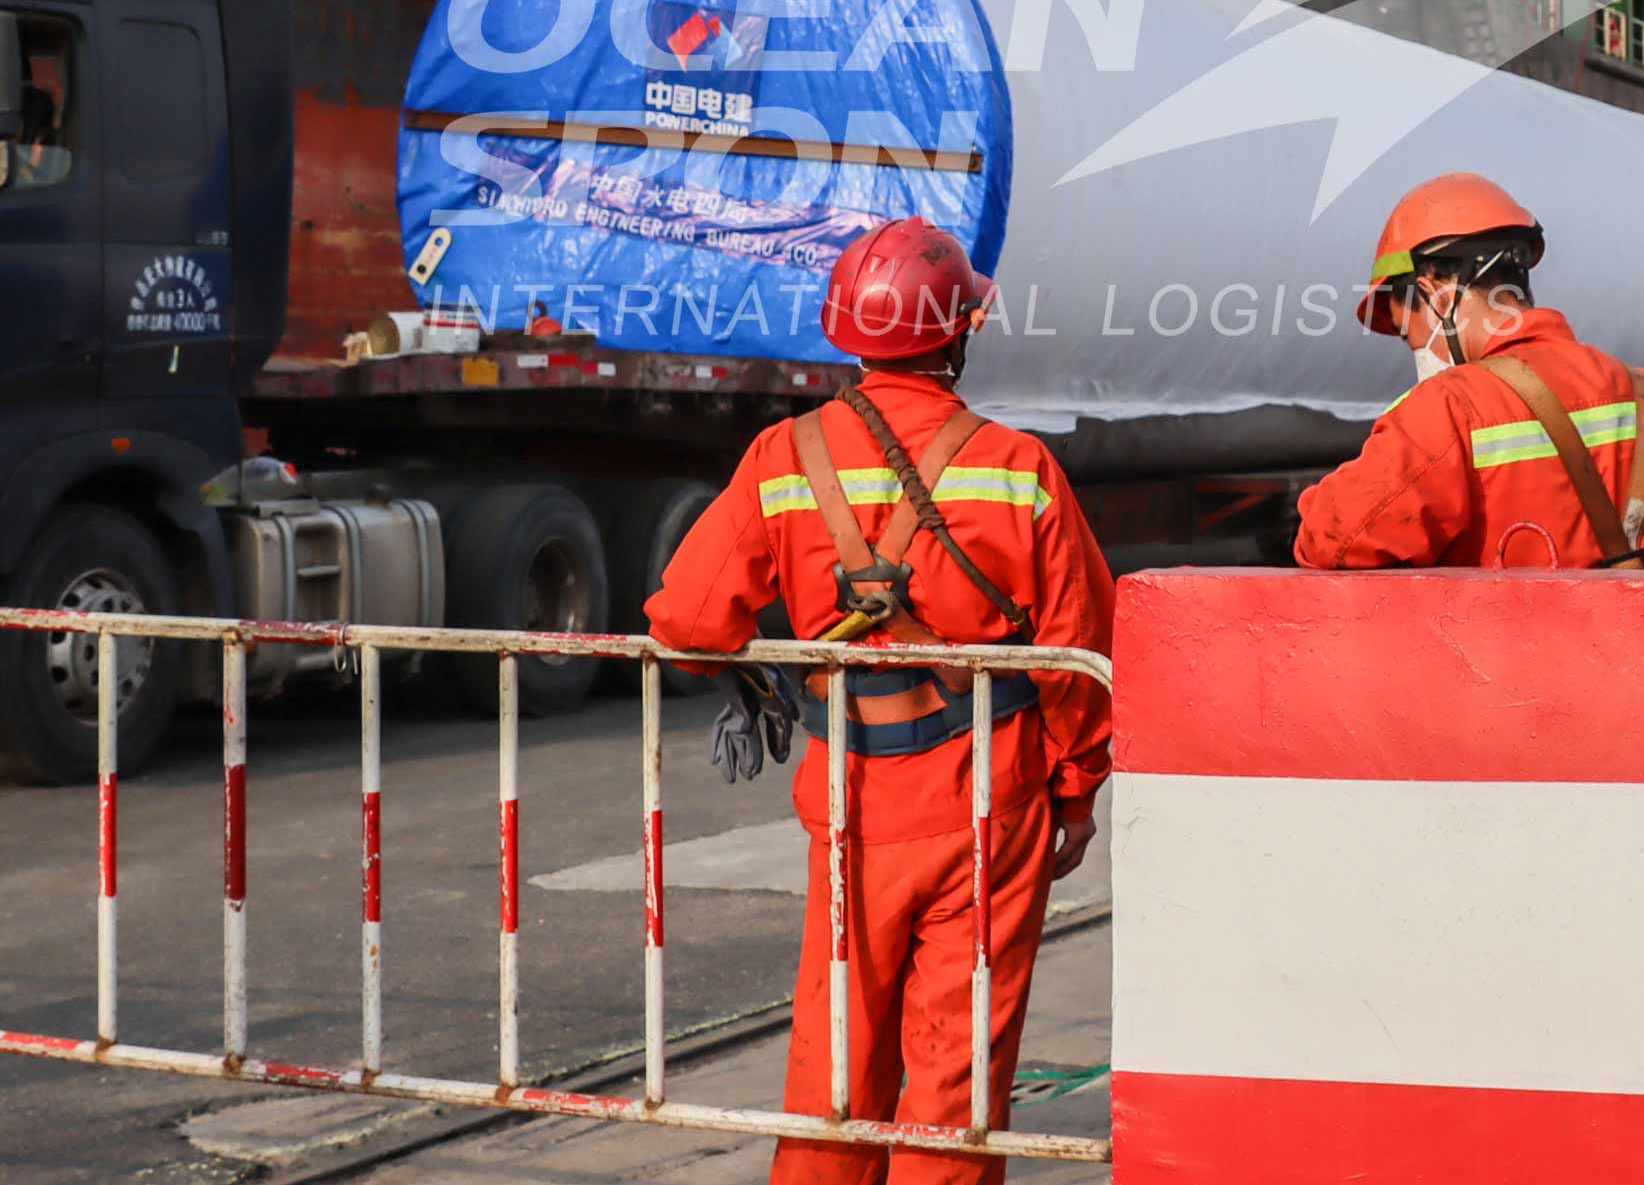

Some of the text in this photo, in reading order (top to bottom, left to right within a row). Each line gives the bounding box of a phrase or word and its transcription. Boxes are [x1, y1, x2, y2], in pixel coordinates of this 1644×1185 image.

[645, 80, 753, 123] 中国电建
[575, 201, 696, 243] ENGINEERING
[706, 230, 775, 257] BUREAU
